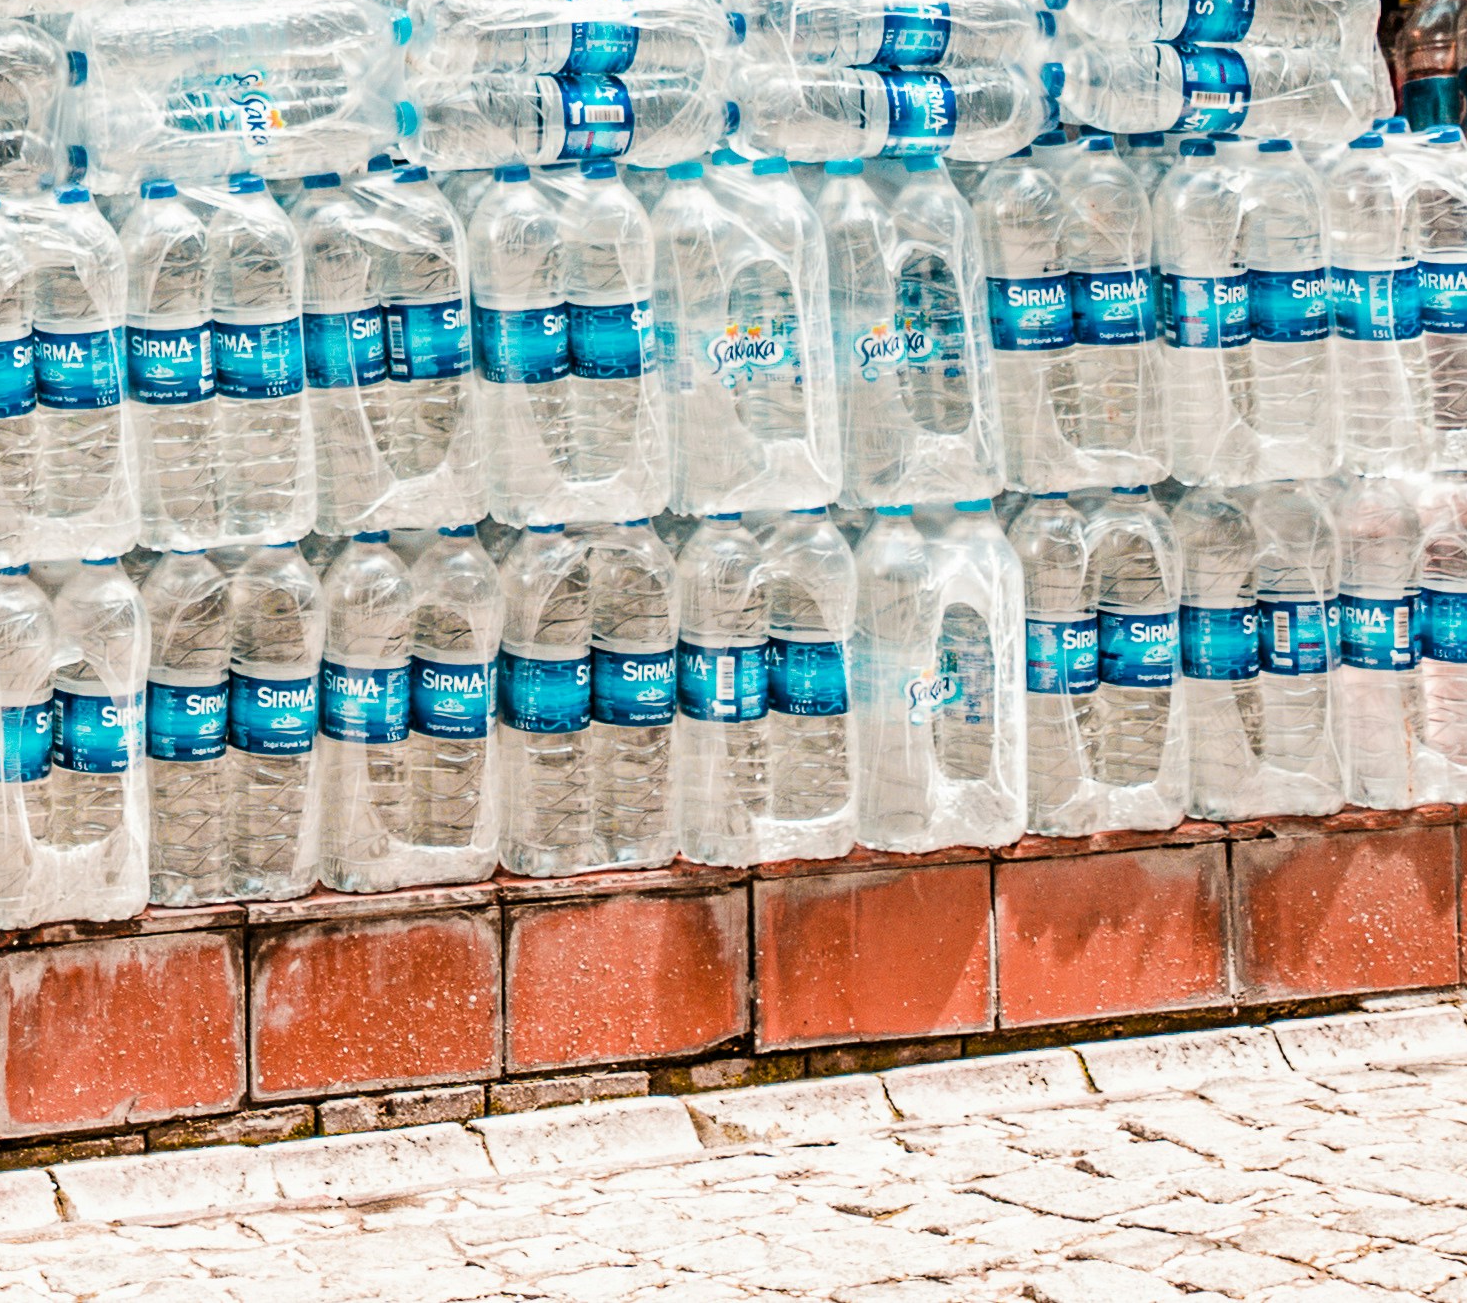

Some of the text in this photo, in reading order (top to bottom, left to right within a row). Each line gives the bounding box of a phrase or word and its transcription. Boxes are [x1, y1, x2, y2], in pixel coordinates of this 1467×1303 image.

[1007, 284, 1067, 307] SIRMA
[1090, 277, 1149, 302] SIRMA
[131, 336, 197, 359] SIRMA
[1342, 606, 1391, 629] IRMA
[1130, 622, 1173, 643] SIRM
[324, 669, 385, 697] SIRMA
[422, 667, 488, 693] SIRMA
[257, 685, 317, 708] SIRMA
